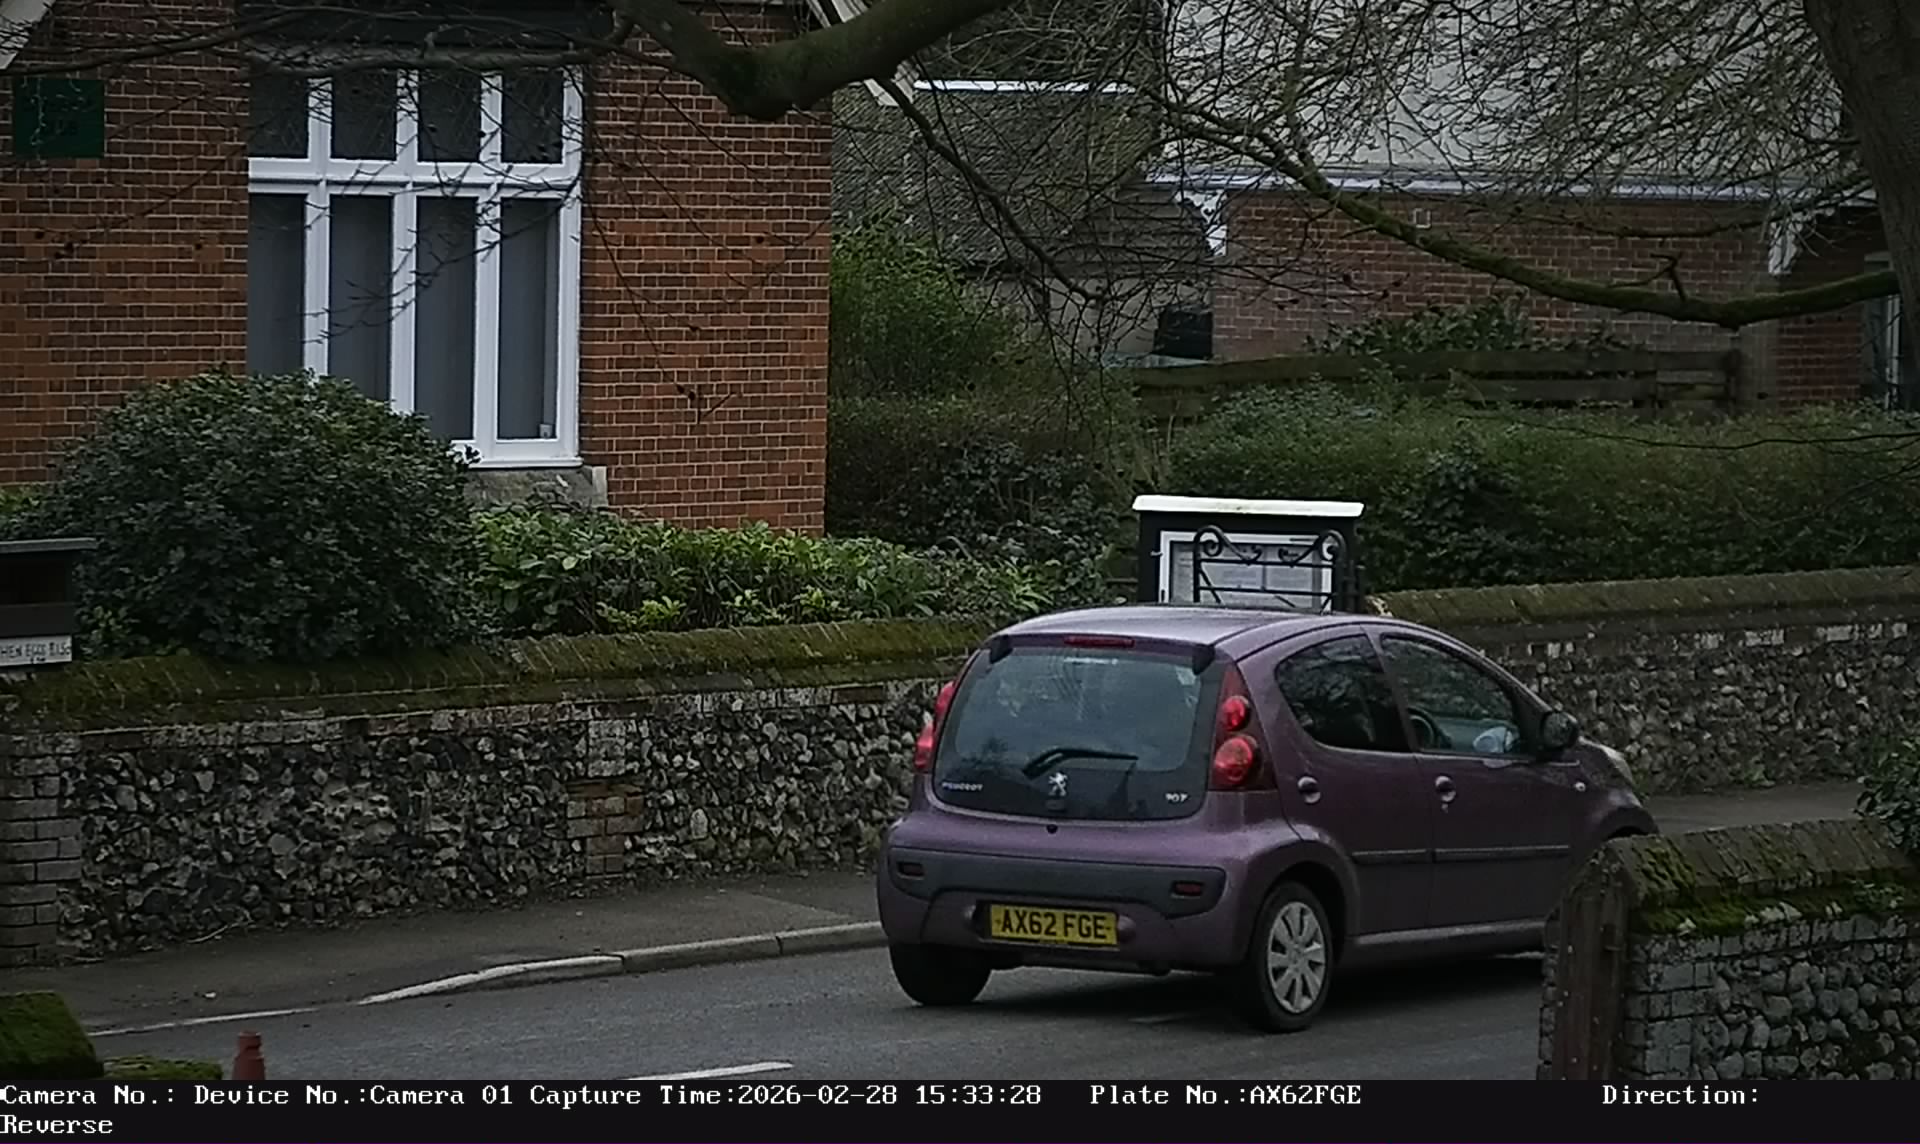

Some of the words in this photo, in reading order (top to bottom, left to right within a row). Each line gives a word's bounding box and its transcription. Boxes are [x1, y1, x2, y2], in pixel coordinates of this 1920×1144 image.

[942, 781, 984, 792] PEUGEOT
[1001, 908, 1057, 937] AX62
[1063, 913, 1108, 939] FGE
